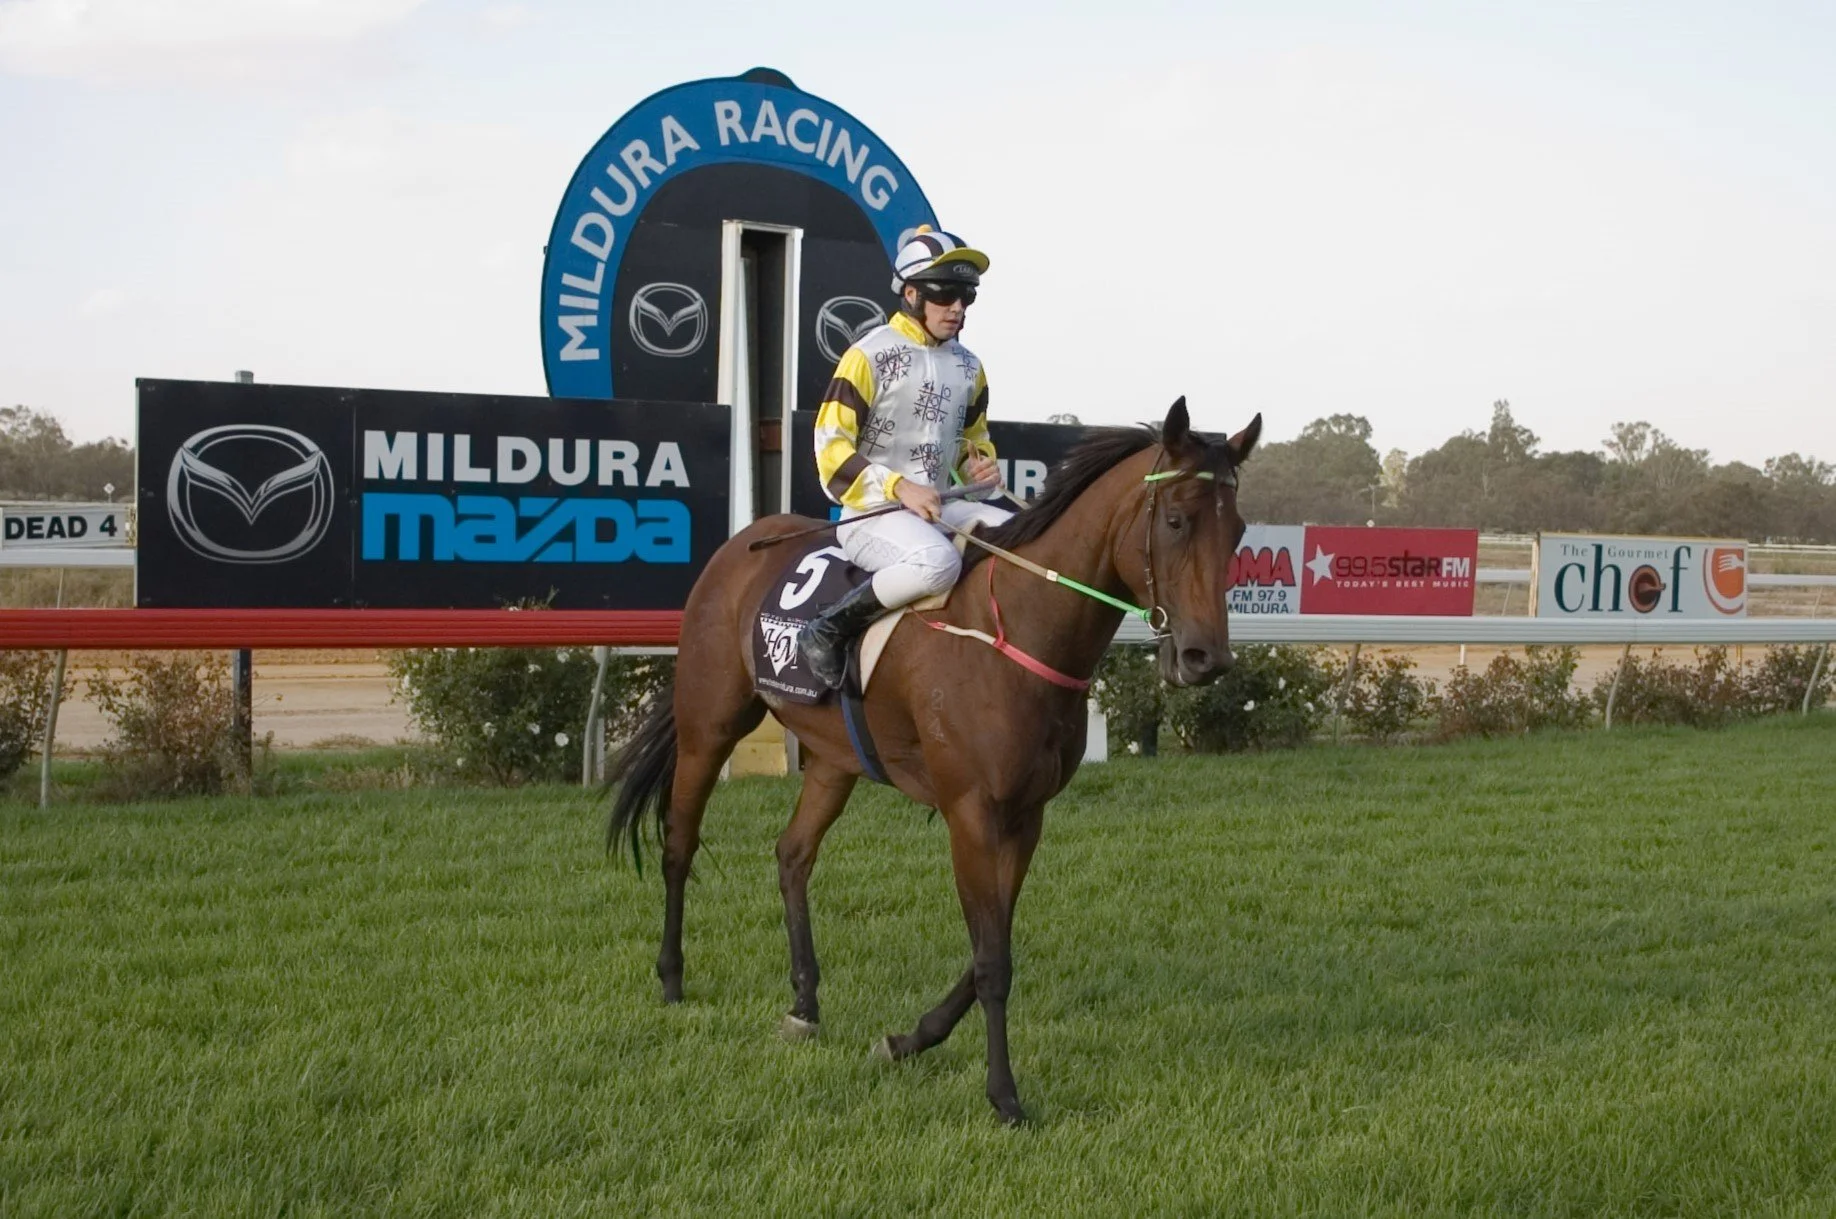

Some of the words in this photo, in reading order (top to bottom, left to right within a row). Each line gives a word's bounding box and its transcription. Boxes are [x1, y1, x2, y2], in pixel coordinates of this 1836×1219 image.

[558, 114, 701, 362] MILDURA
[714, 99, 899, 211] RACING
[364, 430, 691, 488] MILDURA
[4, 515, 89, 540] DEAD
[99, 514, 118, 537] 4
[1561, 544, 1588, 557] The
[1607, 545, 1669, 559] Gourmet
[1396, 580, 1424, 588] BEST
[1433, 580, 1469, 588] MUSIC
[1232, 590, 1253, 602] FM
[1257, 589, 1287, 602] 97.9
